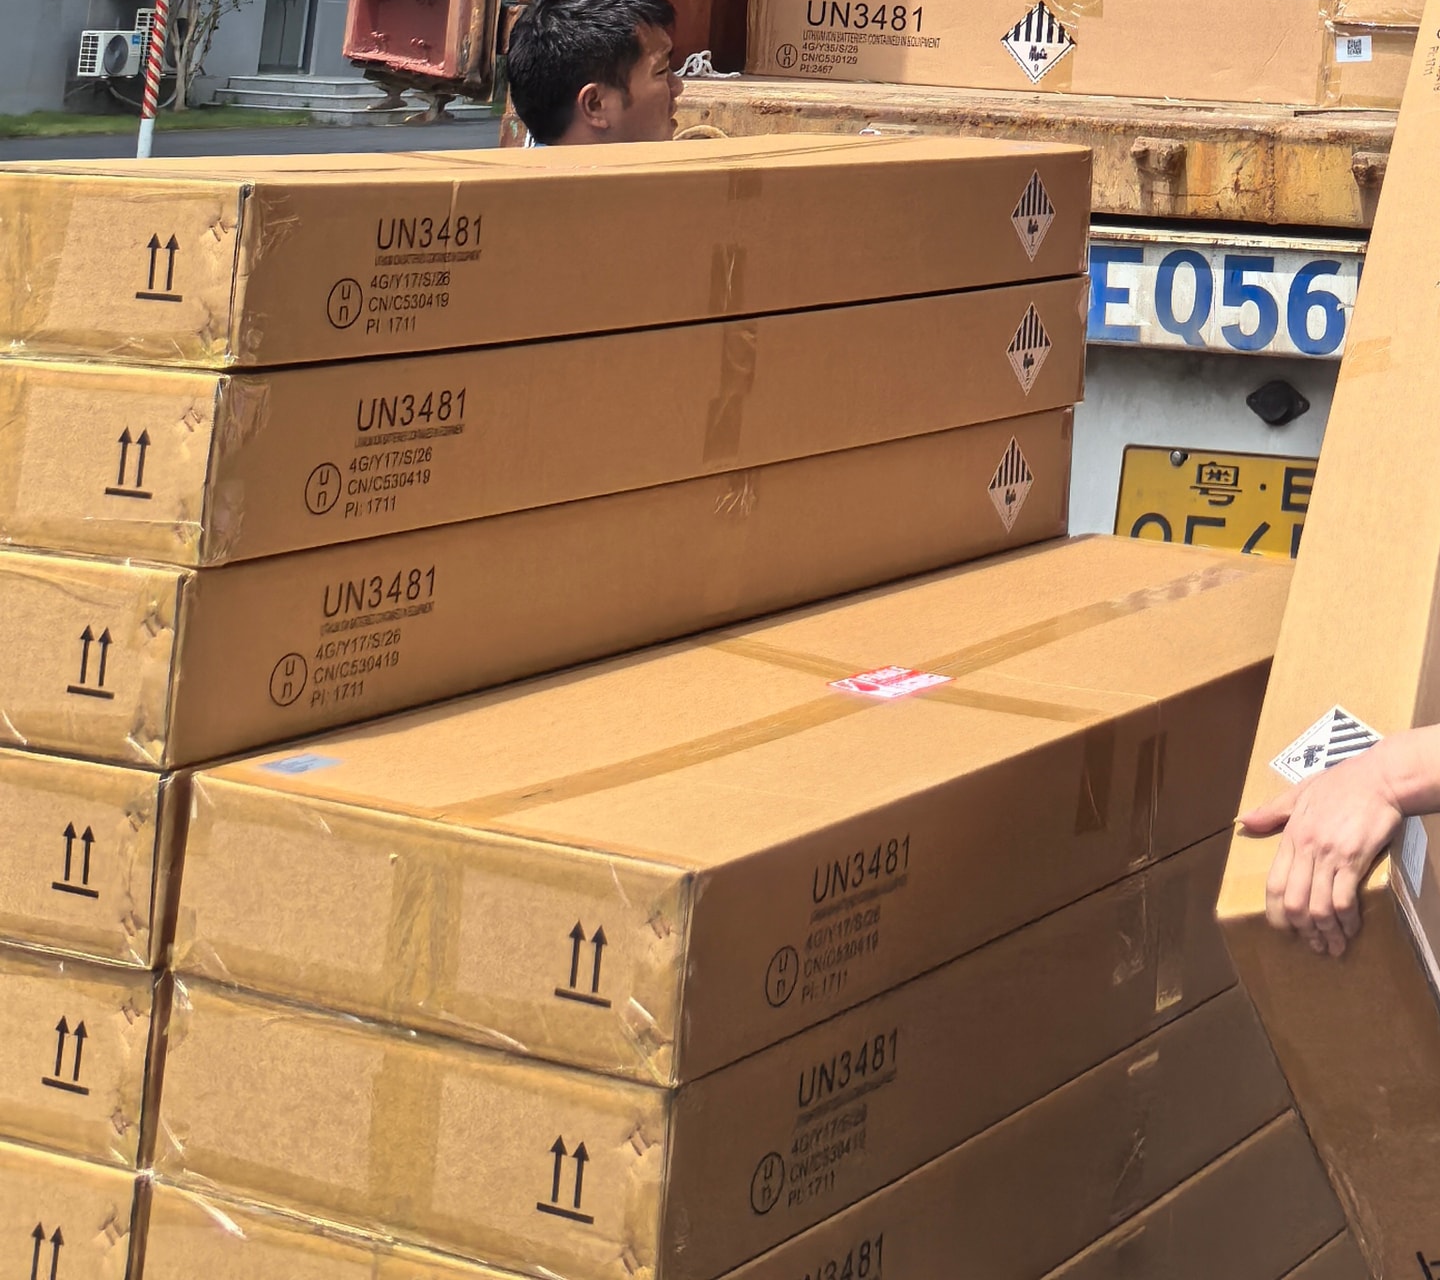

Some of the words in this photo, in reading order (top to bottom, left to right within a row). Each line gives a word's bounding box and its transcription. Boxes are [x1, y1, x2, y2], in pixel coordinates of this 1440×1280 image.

[807, 0, 922, 32] UN3481
[377, 214, 482, 249] UN3481
[371, 271, 450, 289] 4G/Y17/S/26
[369, 293, 449, 312] CN/C530419
[1087, 245, 1363, 355] EQ56
[357, 388, 466, 431] UN3481
[350, 447, 432, 473] 4G/Y17/S/26
[348, 469, 430, 495] CN/C530419
[323, 565, 435, 617] UN3481
[316, 628, 400, 660] 4G/Y17/S/26
[313, 651, 399, 683] CN/C530419
[812, 832, 910, 904] UN3481
[798, 1027, 897, 1108] UN3481
